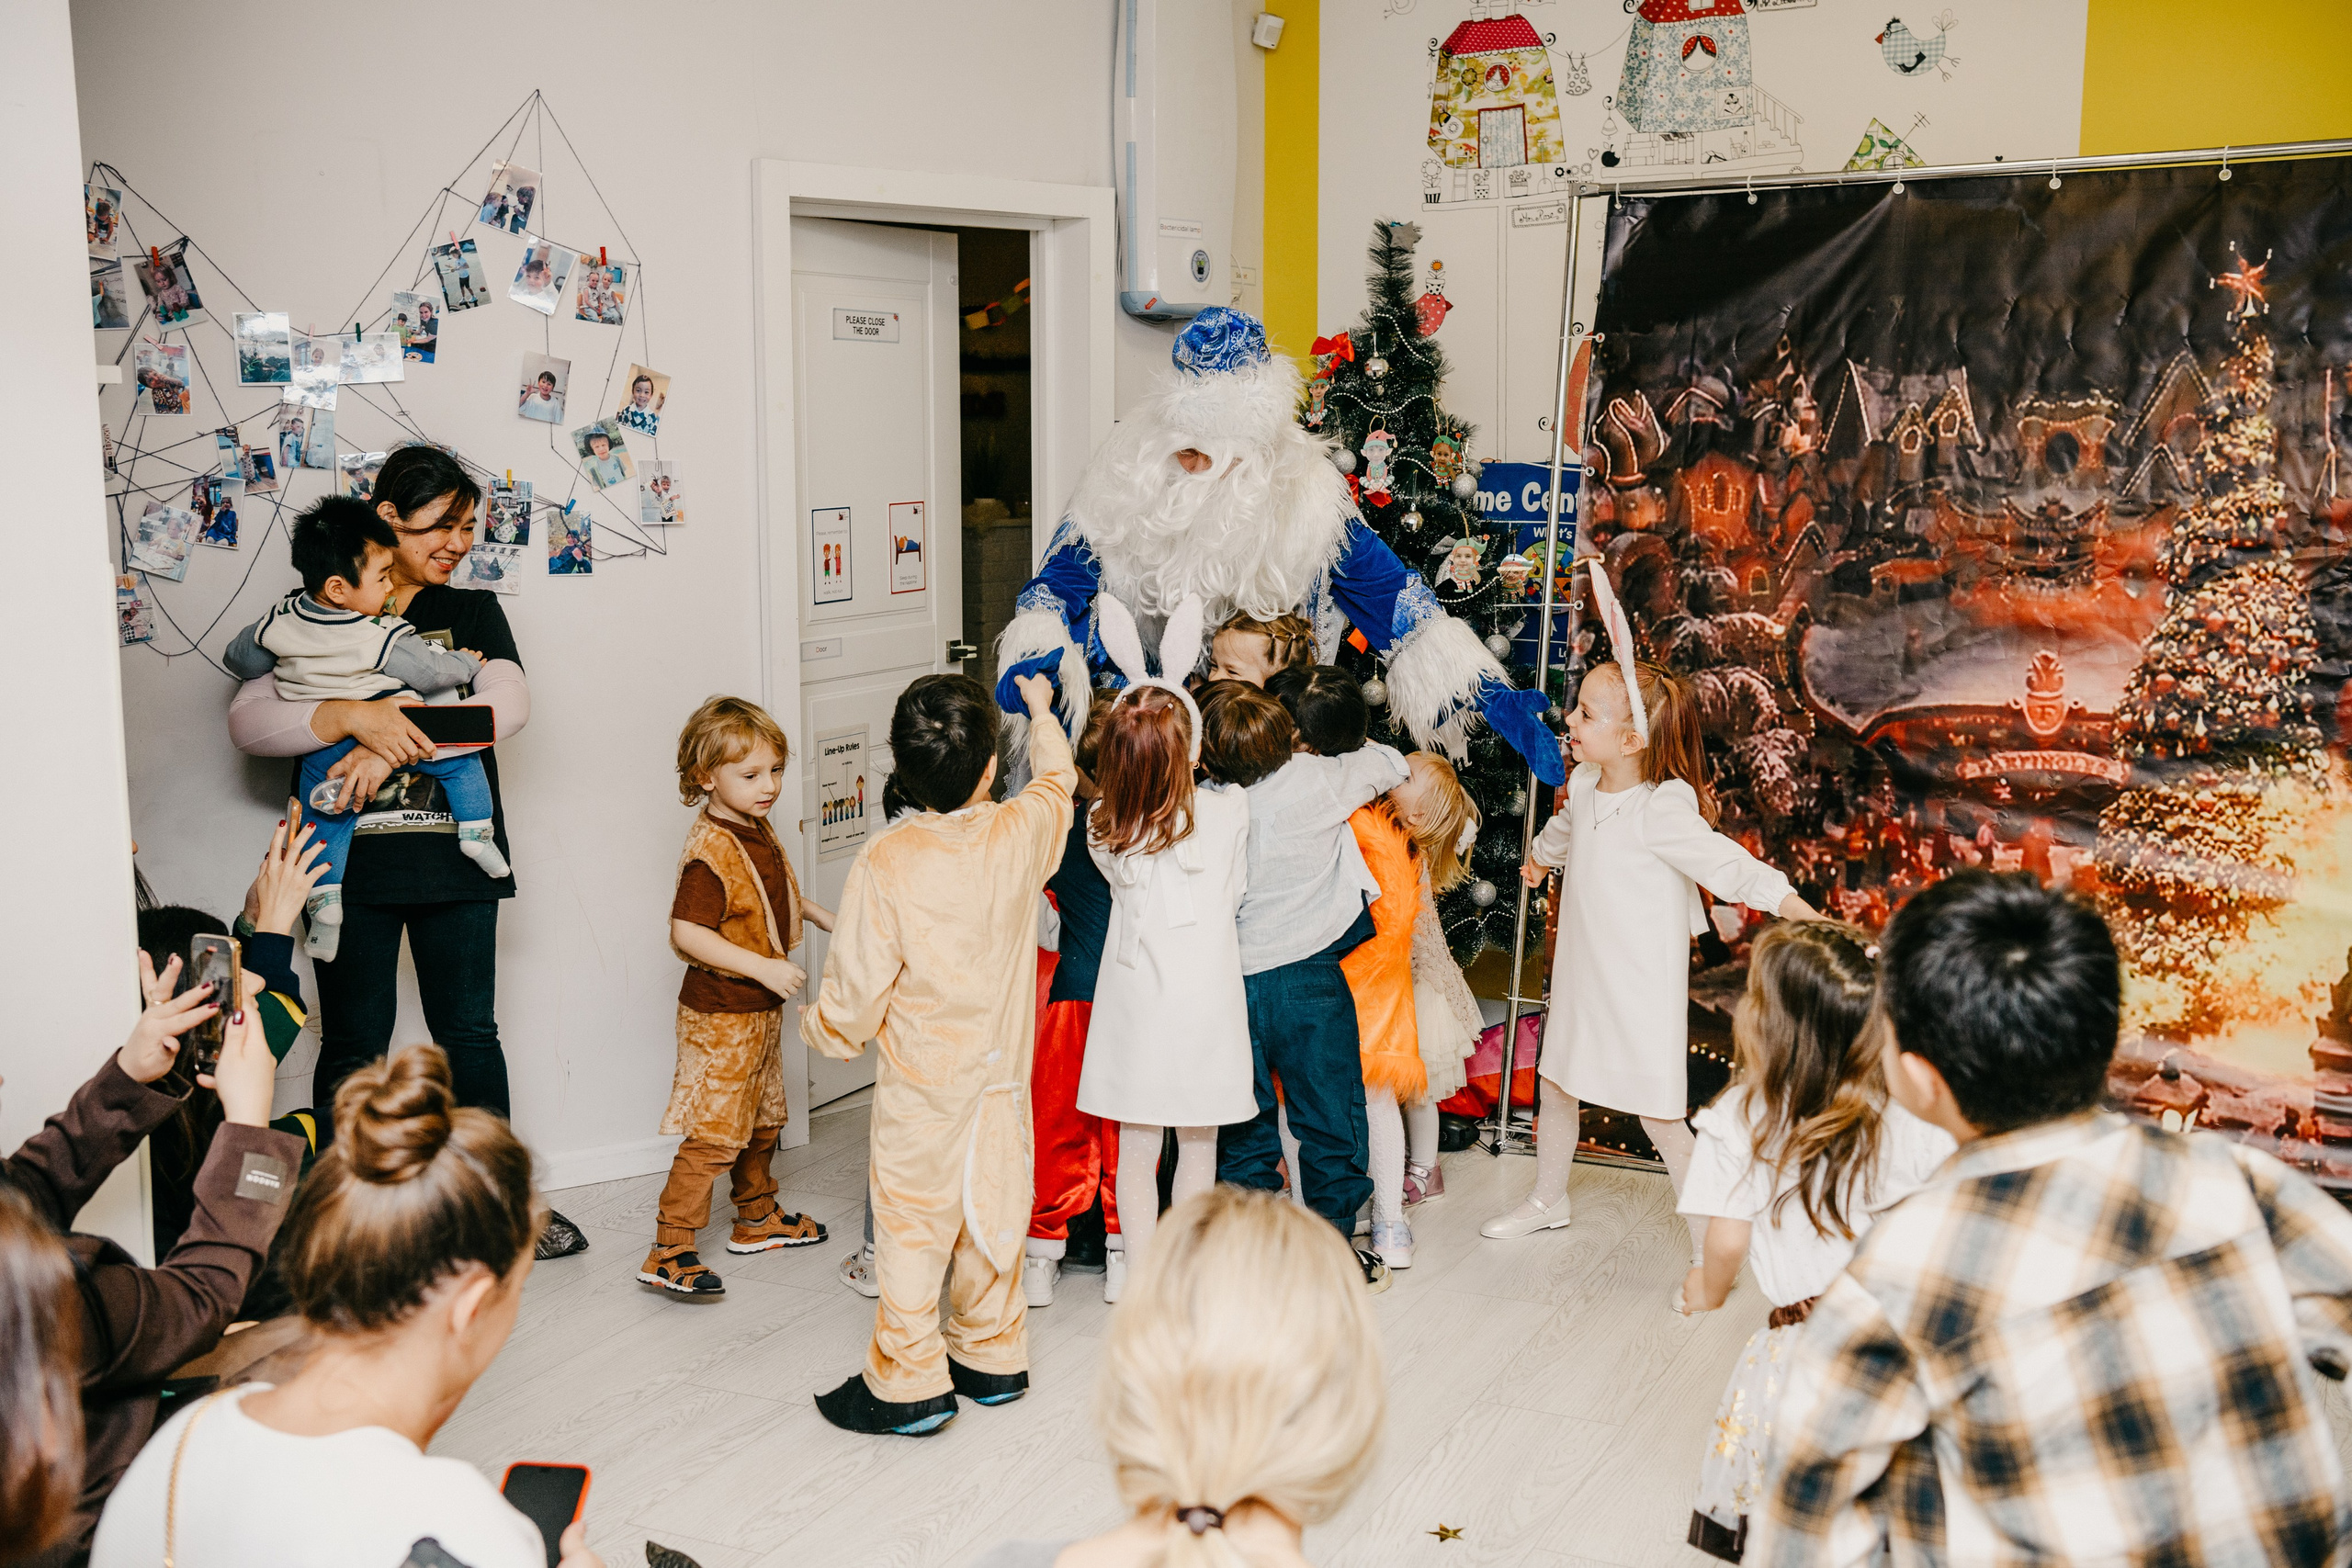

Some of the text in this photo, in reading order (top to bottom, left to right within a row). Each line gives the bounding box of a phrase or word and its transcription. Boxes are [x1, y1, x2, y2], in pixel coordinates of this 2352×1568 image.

[1159, 223, 1188, 232] Bactericidal
[846, 315, 885, 326] PLEASE CLOSE
[853, 326, 879, 336] THE DOOR
[824, 742, 860, 756] Line-Up Rules
